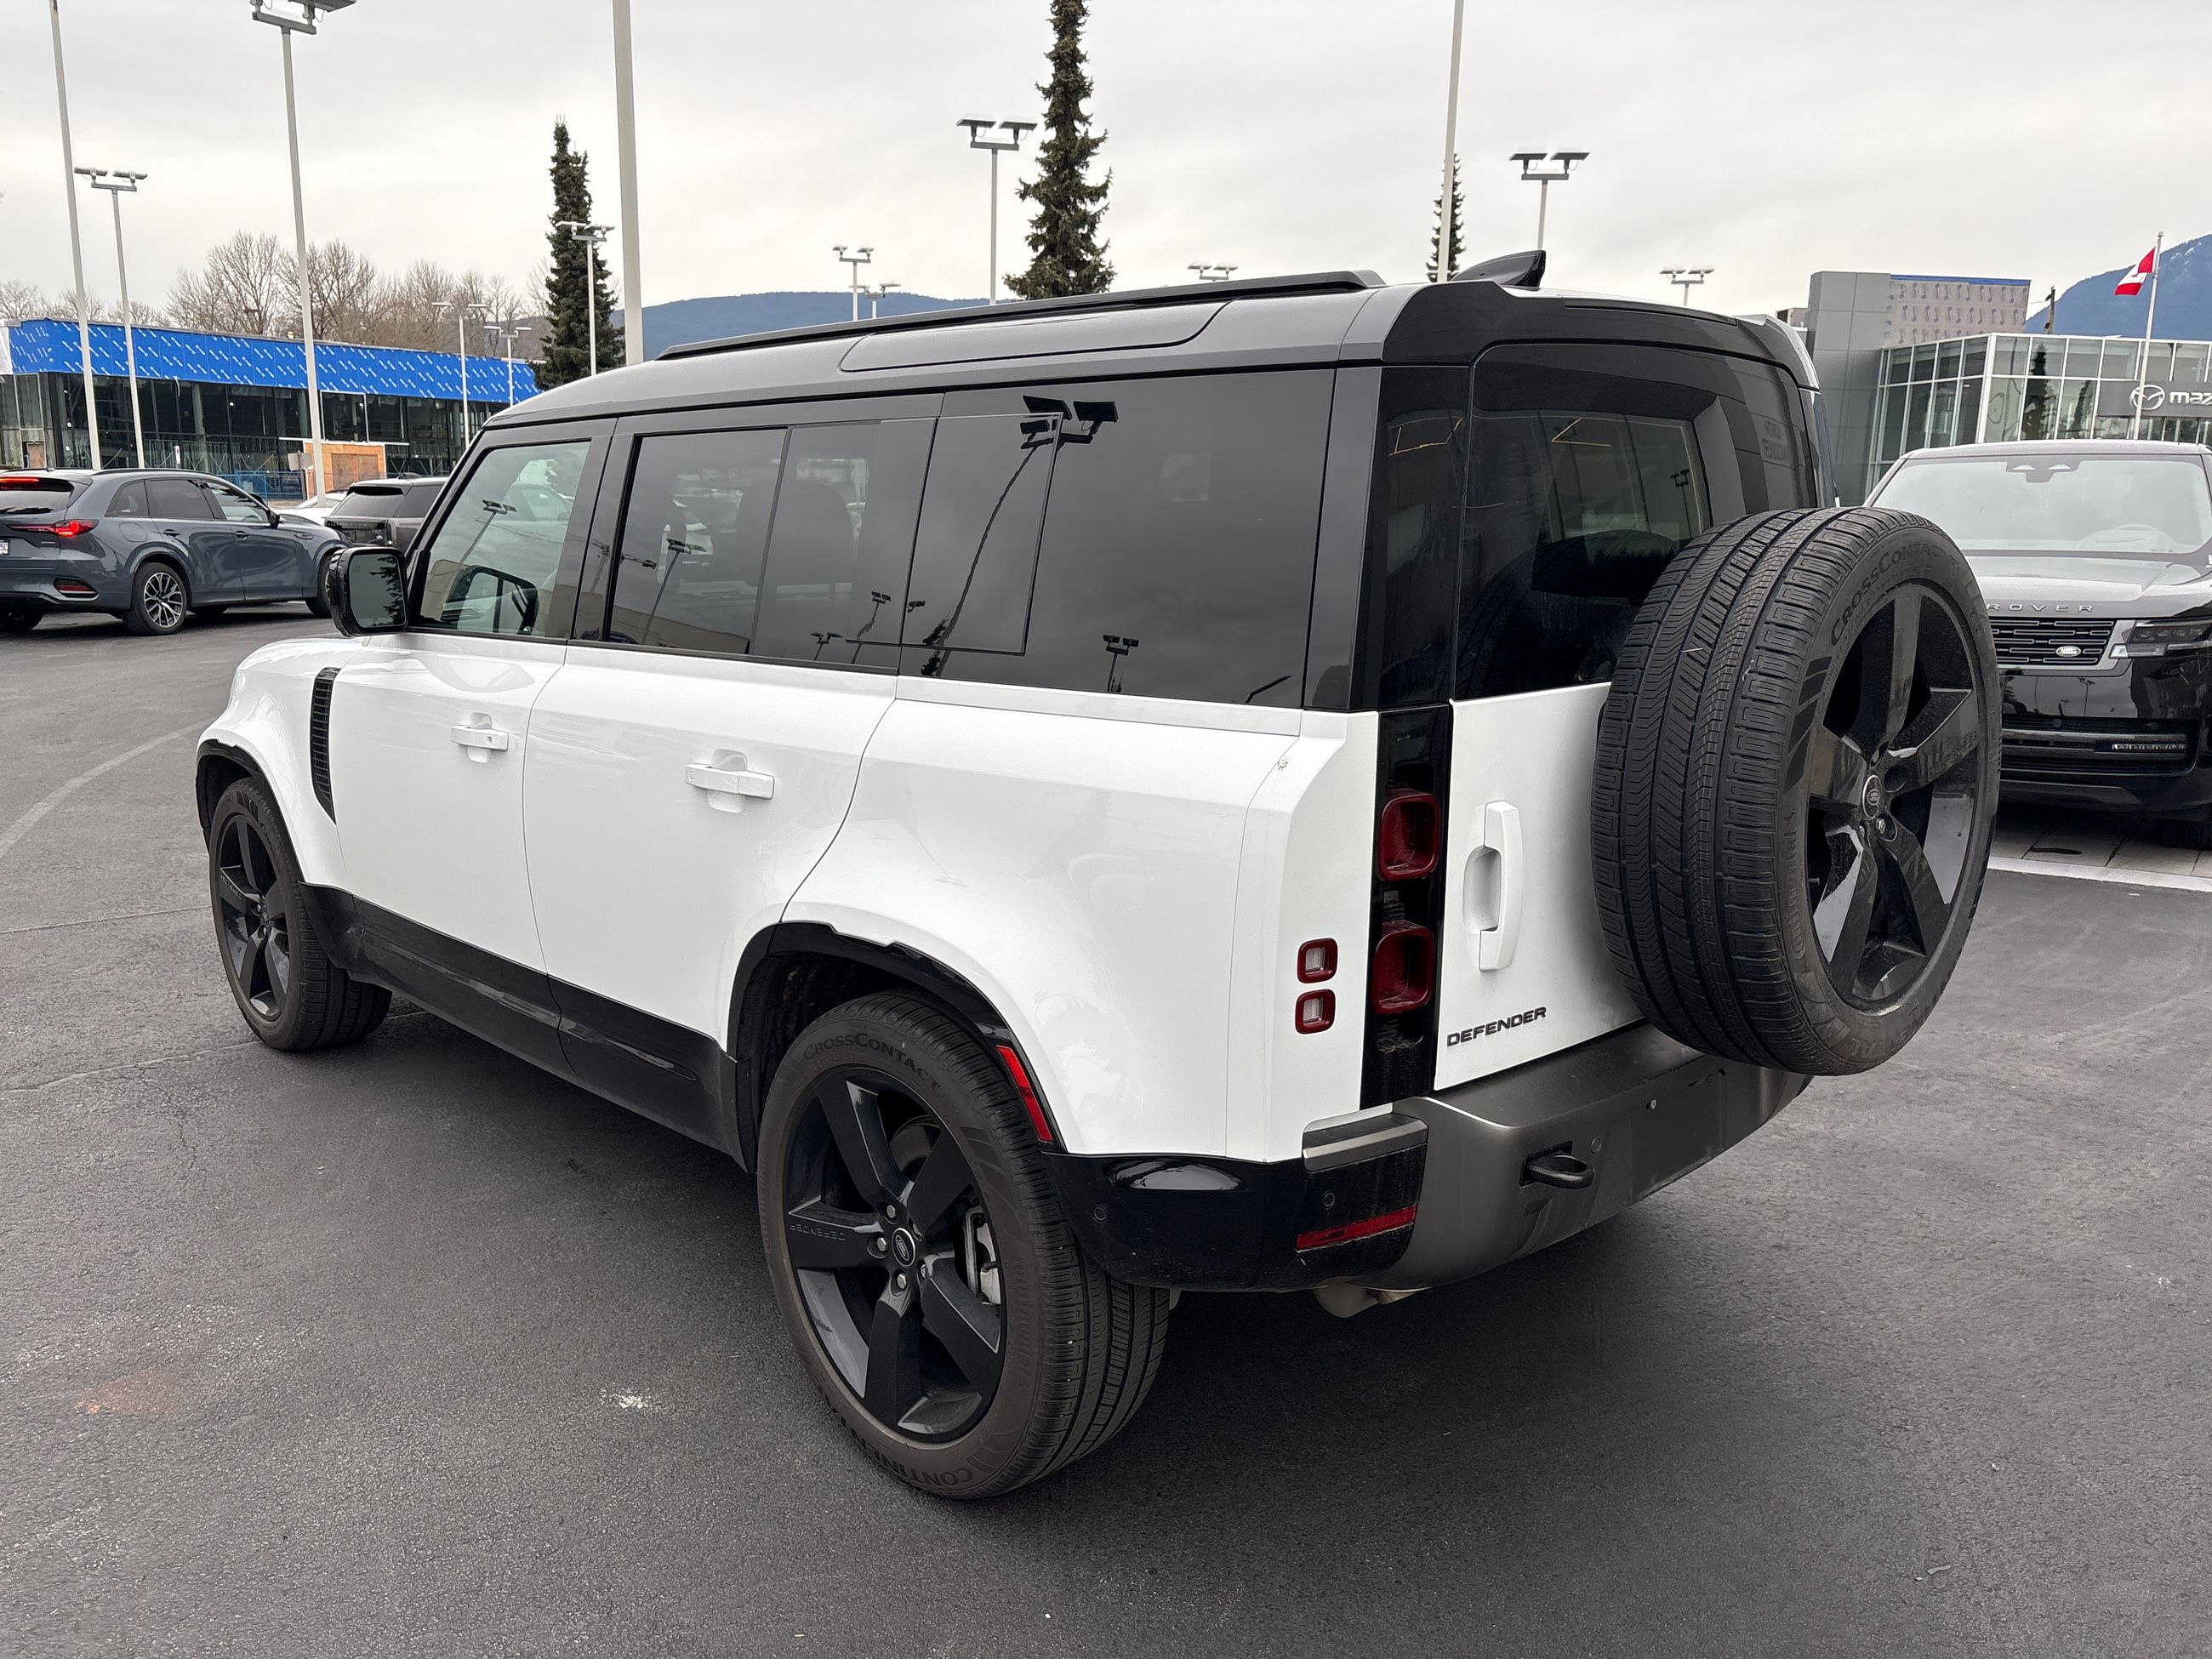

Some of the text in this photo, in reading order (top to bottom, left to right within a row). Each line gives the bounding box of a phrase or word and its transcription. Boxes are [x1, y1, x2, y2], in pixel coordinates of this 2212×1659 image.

[2169, 391, 2212, 406] maz
[1987, 603, 2094, 613] ROVER
[1446, 1006, 1547, 1047] DEFENDER
